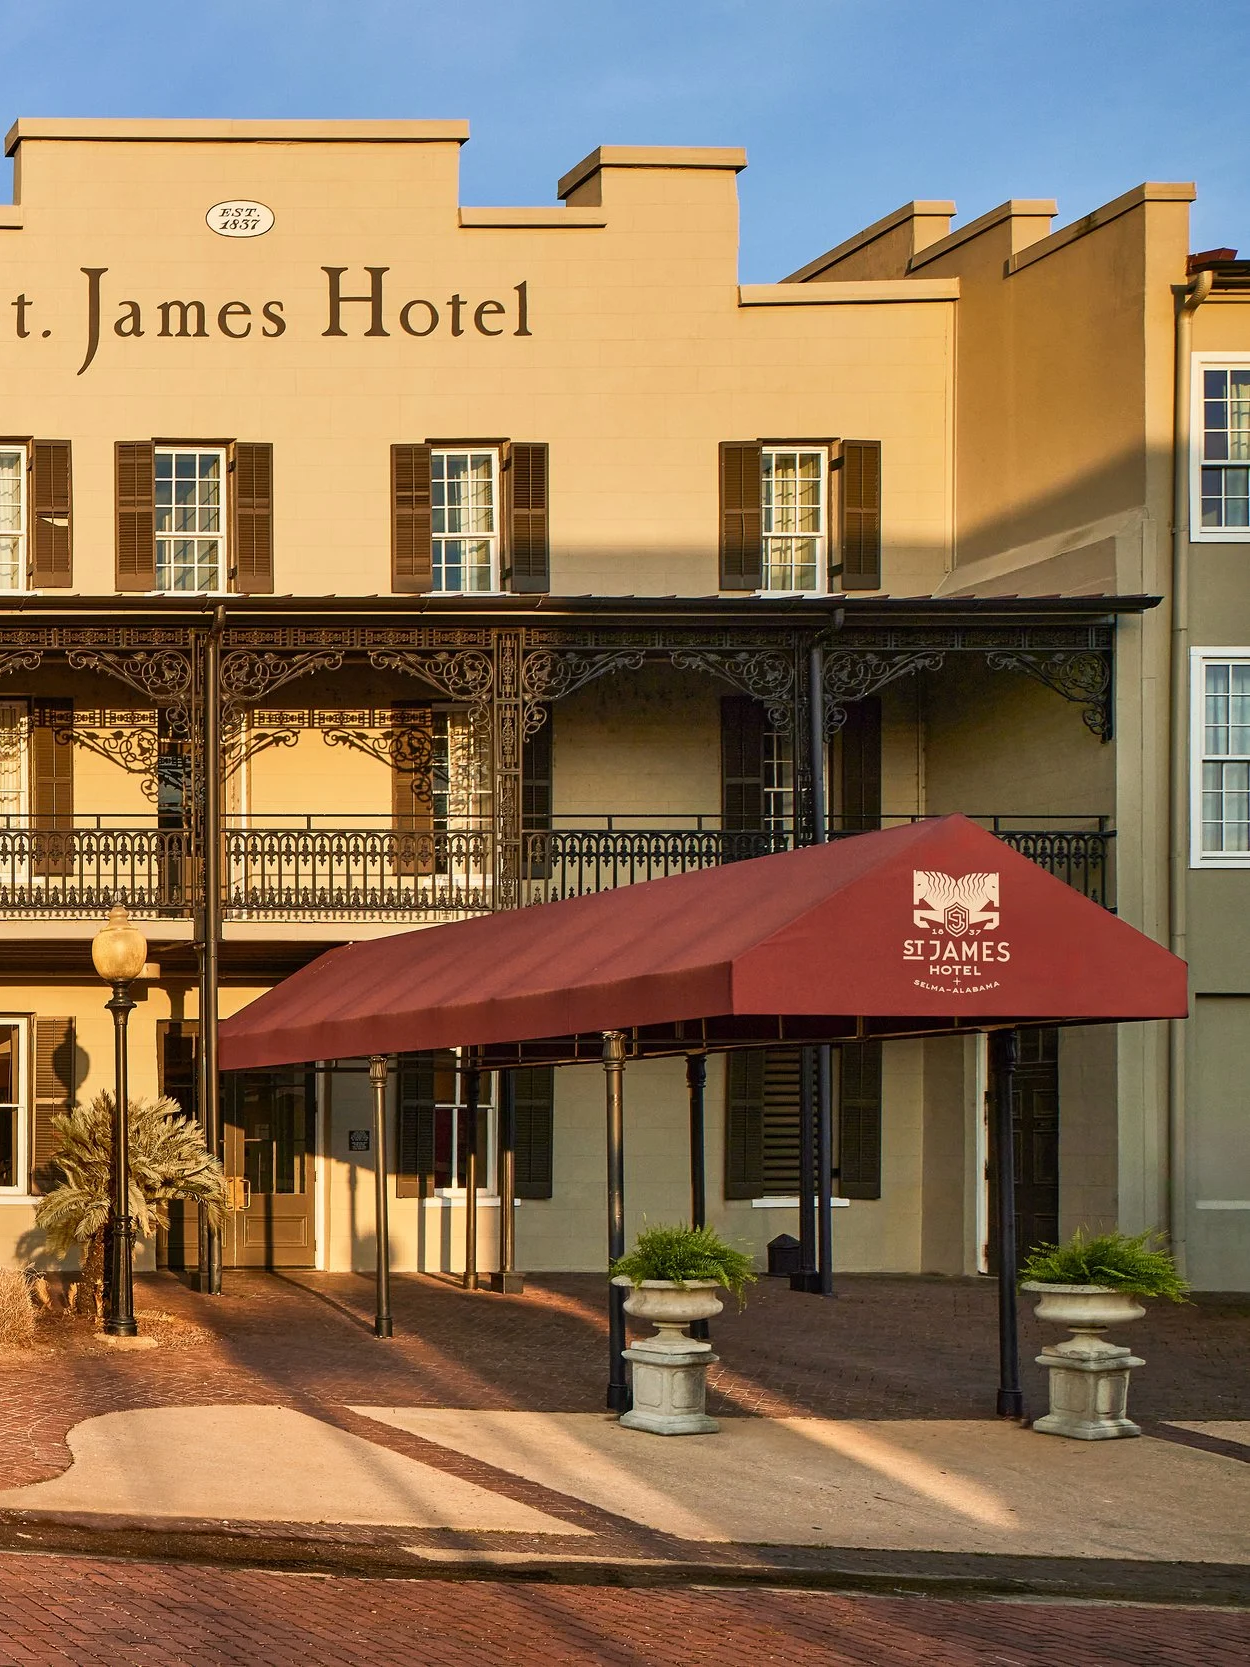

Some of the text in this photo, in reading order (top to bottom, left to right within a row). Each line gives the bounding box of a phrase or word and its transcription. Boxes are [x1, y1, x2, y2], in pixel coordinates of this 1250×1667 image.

[219, 208, 260, 217] EST.
[219, 219, 261, 230] 1837
[76, 266, 287, 376] James
[320, 266, 533, 338] Hotel
[903, 940, 1011, 962] ST JAMES
[929, 965, 982, 976] HOTEL
